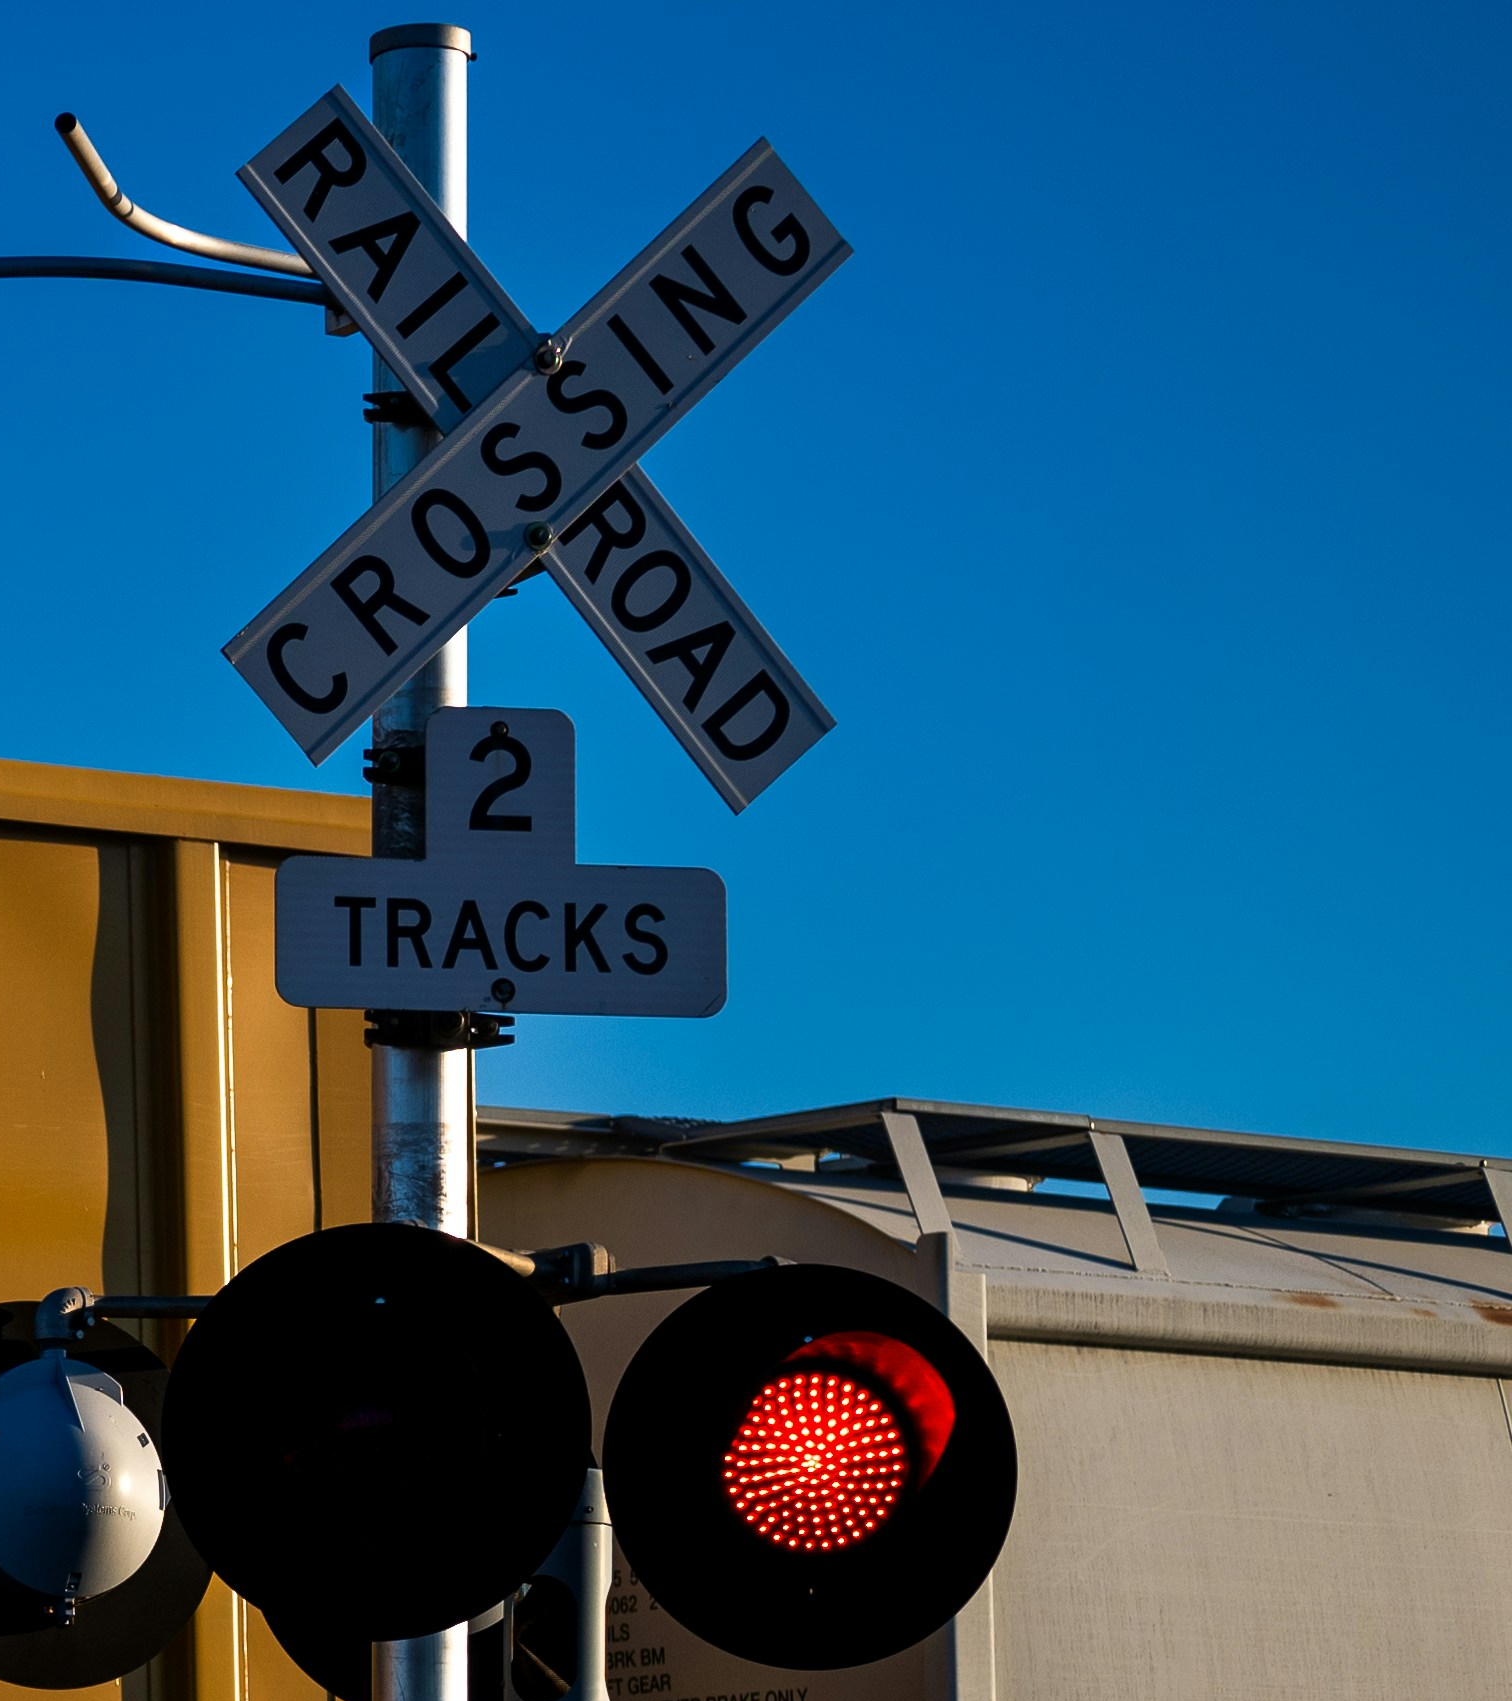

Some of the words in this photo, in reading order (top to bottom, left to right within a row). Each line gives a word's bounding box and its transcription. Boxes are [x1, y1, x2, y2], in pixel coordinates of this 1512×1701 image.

[265, 185, 811, 715] CROSSING
[274, 118, 500, 412] RAIL
[559, 480, 789, 761] ROAD
[469, 734, 532, 831] 2
[334, 896, 668, 976] TRACKS
[628, 1674, 671, 1695] GEAR
[640, 1647, 665, 1666] BM
